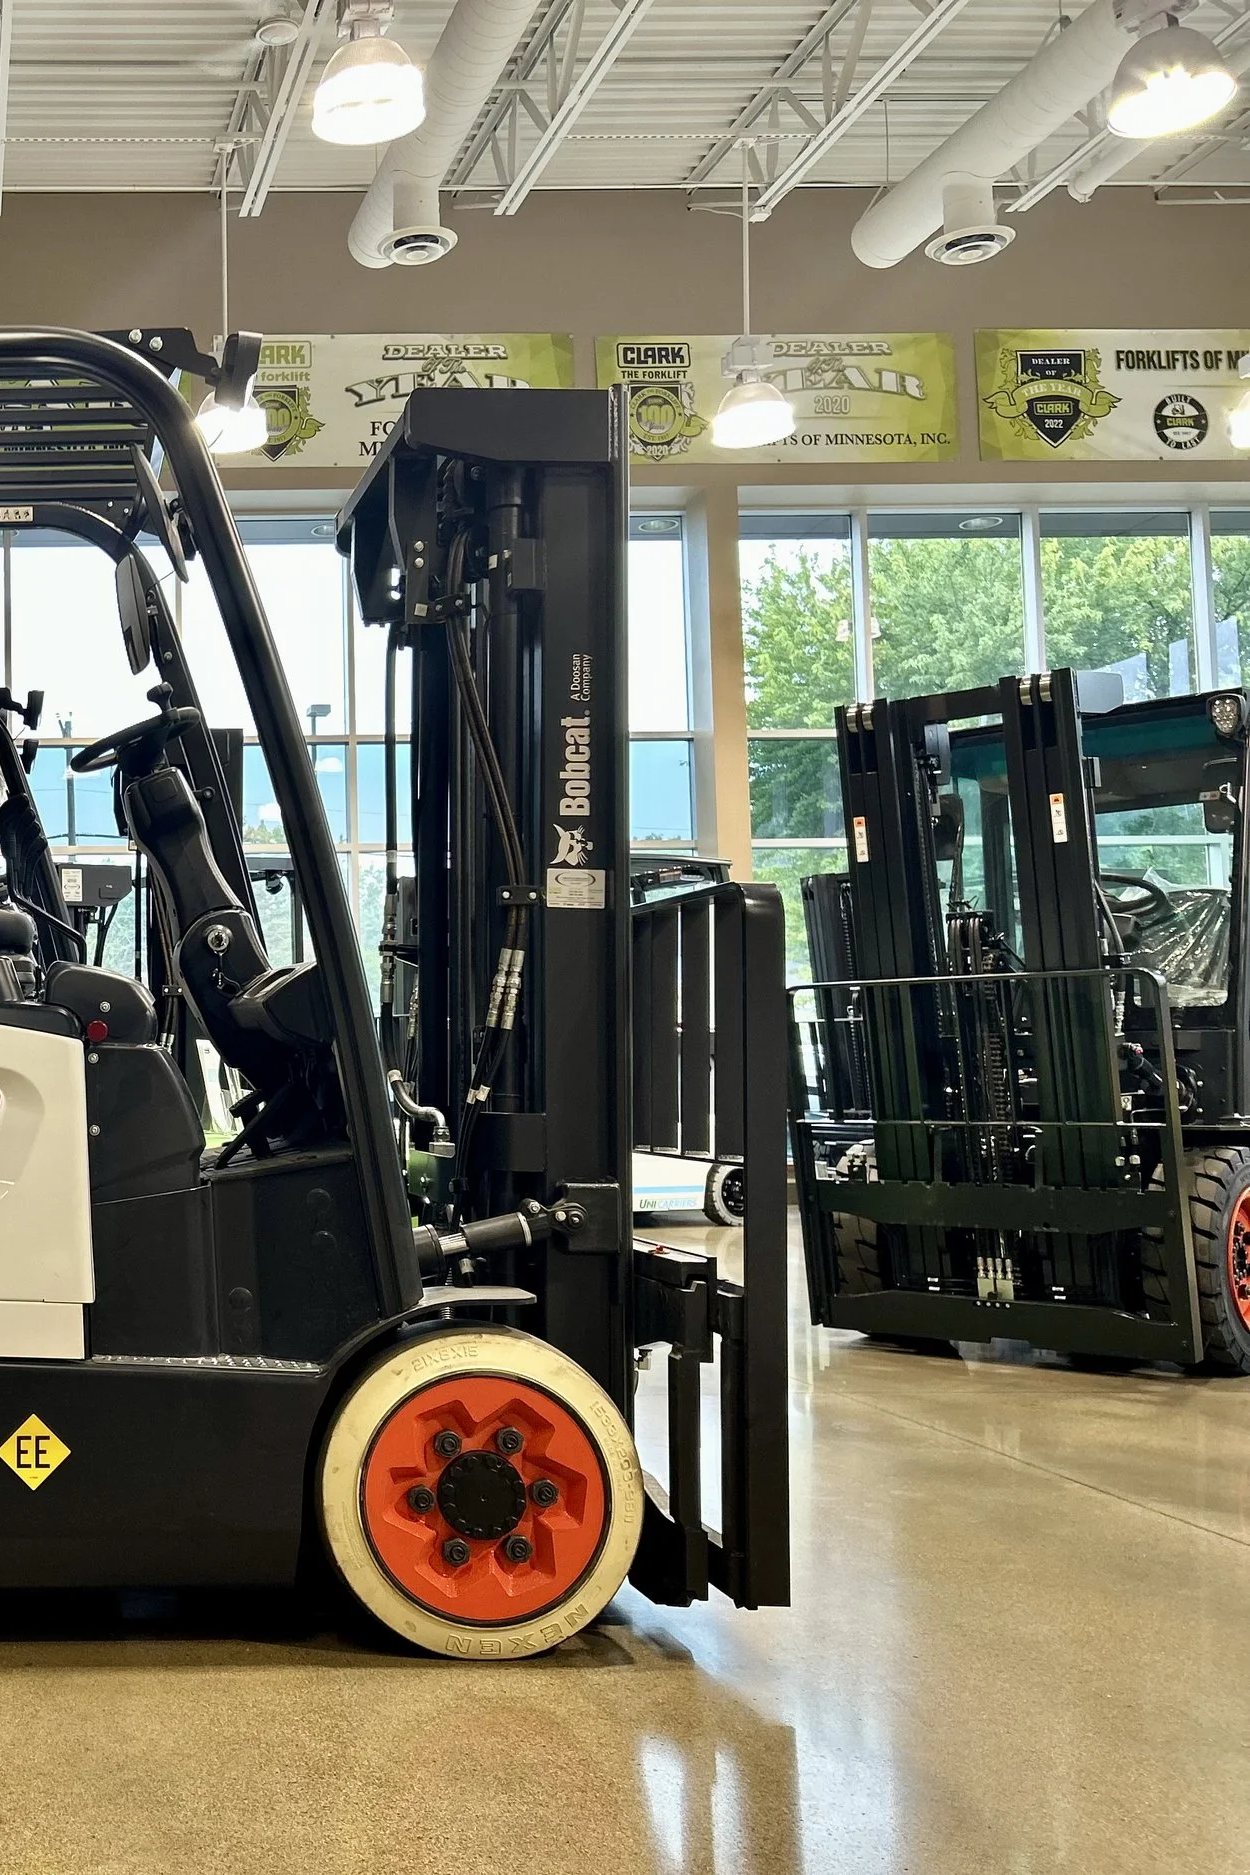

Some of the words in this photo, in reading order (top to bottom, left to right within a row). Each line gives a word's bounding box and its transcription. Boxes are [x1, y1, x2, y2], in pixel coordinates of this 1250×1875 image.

[258, 345, 306, 365] ARK
[382, 344, 508, 360] DEALER
[622, 346, 685, 365] CLARK
[767, 341, 892, 356] DEALER
[1116, 349, 1200, 370] FORKLIFTS
[1203, 349, 1223, 370] OF
[261, 371, 311, 381] forklift
[621, 370, 639, 379] THE
[642, 370, 688, 379] FORKLIFT
[762, 364, 927, 400] EAR
[1022, 383, 1048, 397] THE
[1050, 383, 1082, 396] YEAR
[814, 395, 851, 414] 2020
[1165, 395, 1192, 405] BUILT
[1036, 403, 1070, 413] CLARK
[1044, 419, 1064, 429] 2022
[1166, 418, 1195, 427] CLARK
[801, 434, 821, 445] OF
[825, 433, 917, 447] MINNESOTA,
[921, 433, 951, 445] INC.
[1181, 437, 1202, 450] LAST
[570, 653, 581, 691] Doosan
[580, 654, 593, 701] Company
[570, 692, 581, 701] A
[16, 1435, 51, 1469] EE
[445, 1603, 590, 1656] NEXEN
